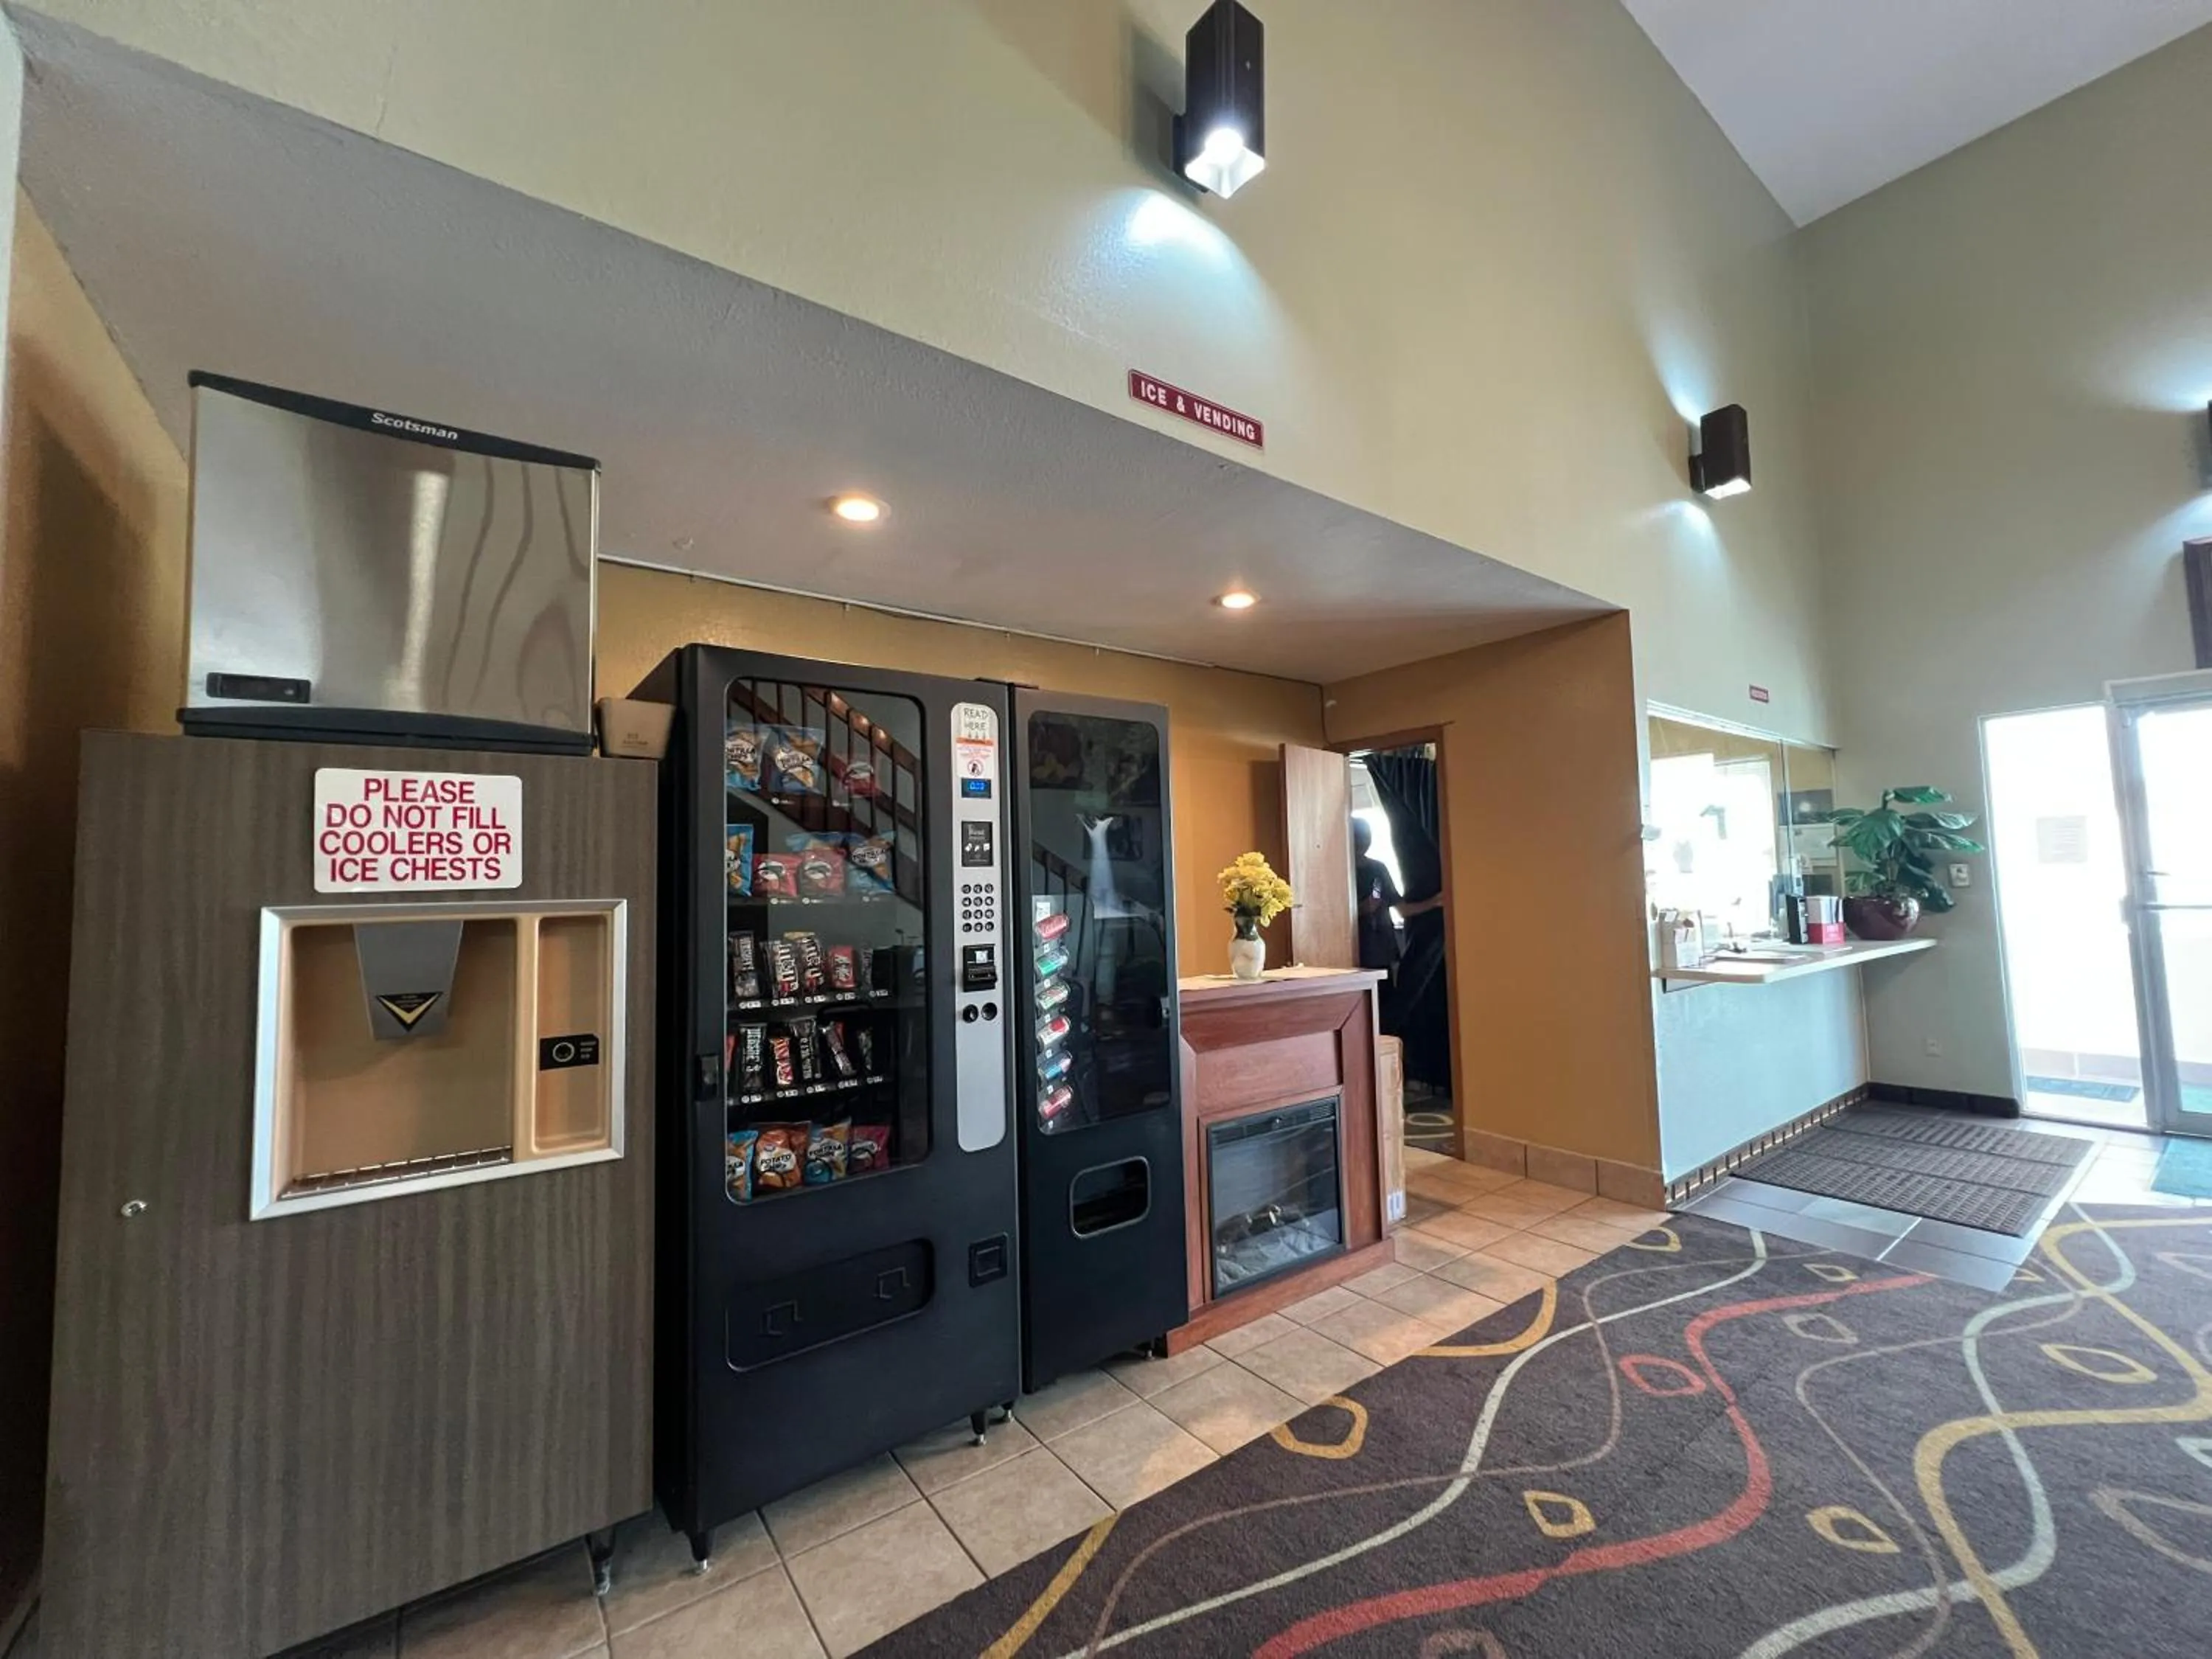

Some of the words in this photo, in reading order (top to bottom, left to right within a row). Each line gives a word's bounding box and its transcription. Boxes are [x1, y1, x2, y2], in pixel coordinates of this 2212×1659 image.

[1141, 380, 1167, 406] ICE
[1176, 395, 1185, 413] &
[1194, 402, 1255, 439] VENDING
[371, 412, 458, 440] Scotsman
[964, 708, 988, 719] READ
[964, 722, 986, 731] HERE
[364, 778, 475, 804] PLEASE
[326, 803, 372, 828] DO
[383, 805, 442, 830] NOT
[452, 807, 507, 830] FILL
[319, 830, 463, 855] COOLERS
[473, 832, 512, 855] OR
[330, 858, 379, 883] ICE
[389, 858, 501, 881] CHESTS
[760, 1154, 792, 1166] POTATO
